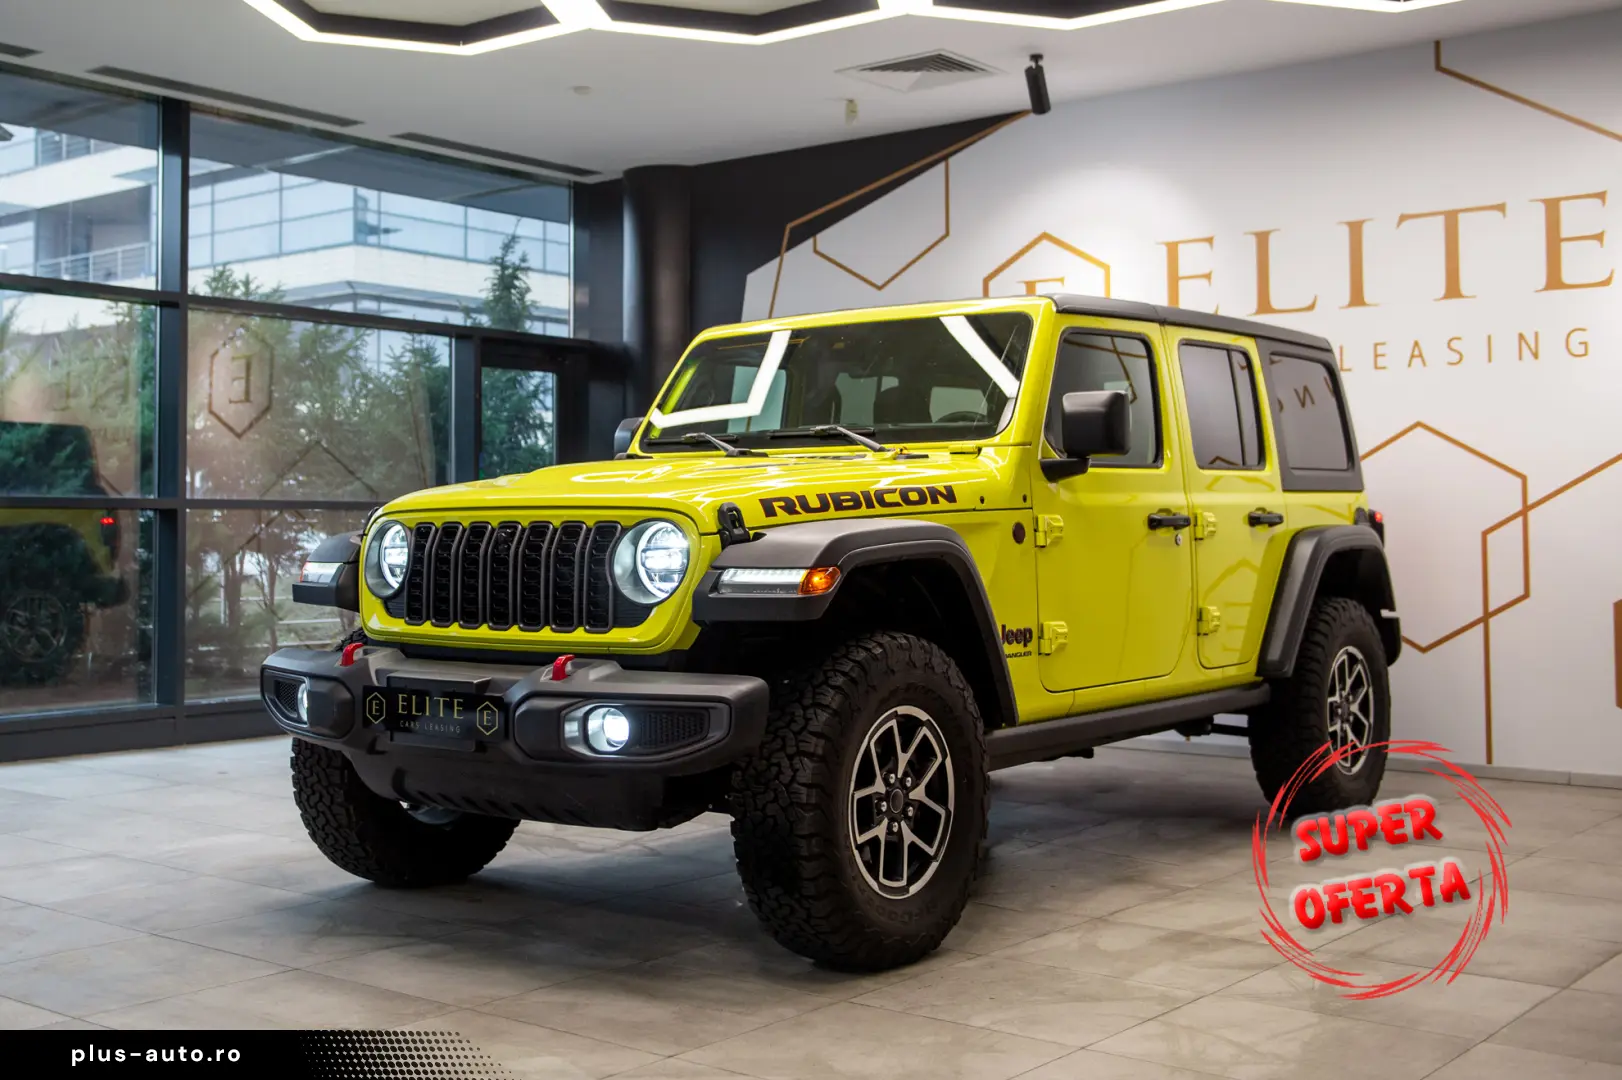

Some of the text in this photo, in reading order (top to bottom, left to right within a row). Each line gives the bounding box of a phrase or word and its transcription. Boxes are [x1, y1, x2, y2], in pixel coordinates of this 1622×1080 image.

[1156, 190, 1615, 316] ELITE
[1338, 327, 1590, 372] LEASING
[758, 485, 958, 518] RUBICON
[1001, 624, 1033, 648] Jeep
[372, 700, 380, 716] E
[398, 694, 464, 720] ELITE
[483, 710, 492, 726] E
[400, 720, 461, 734] CARS LEASING
